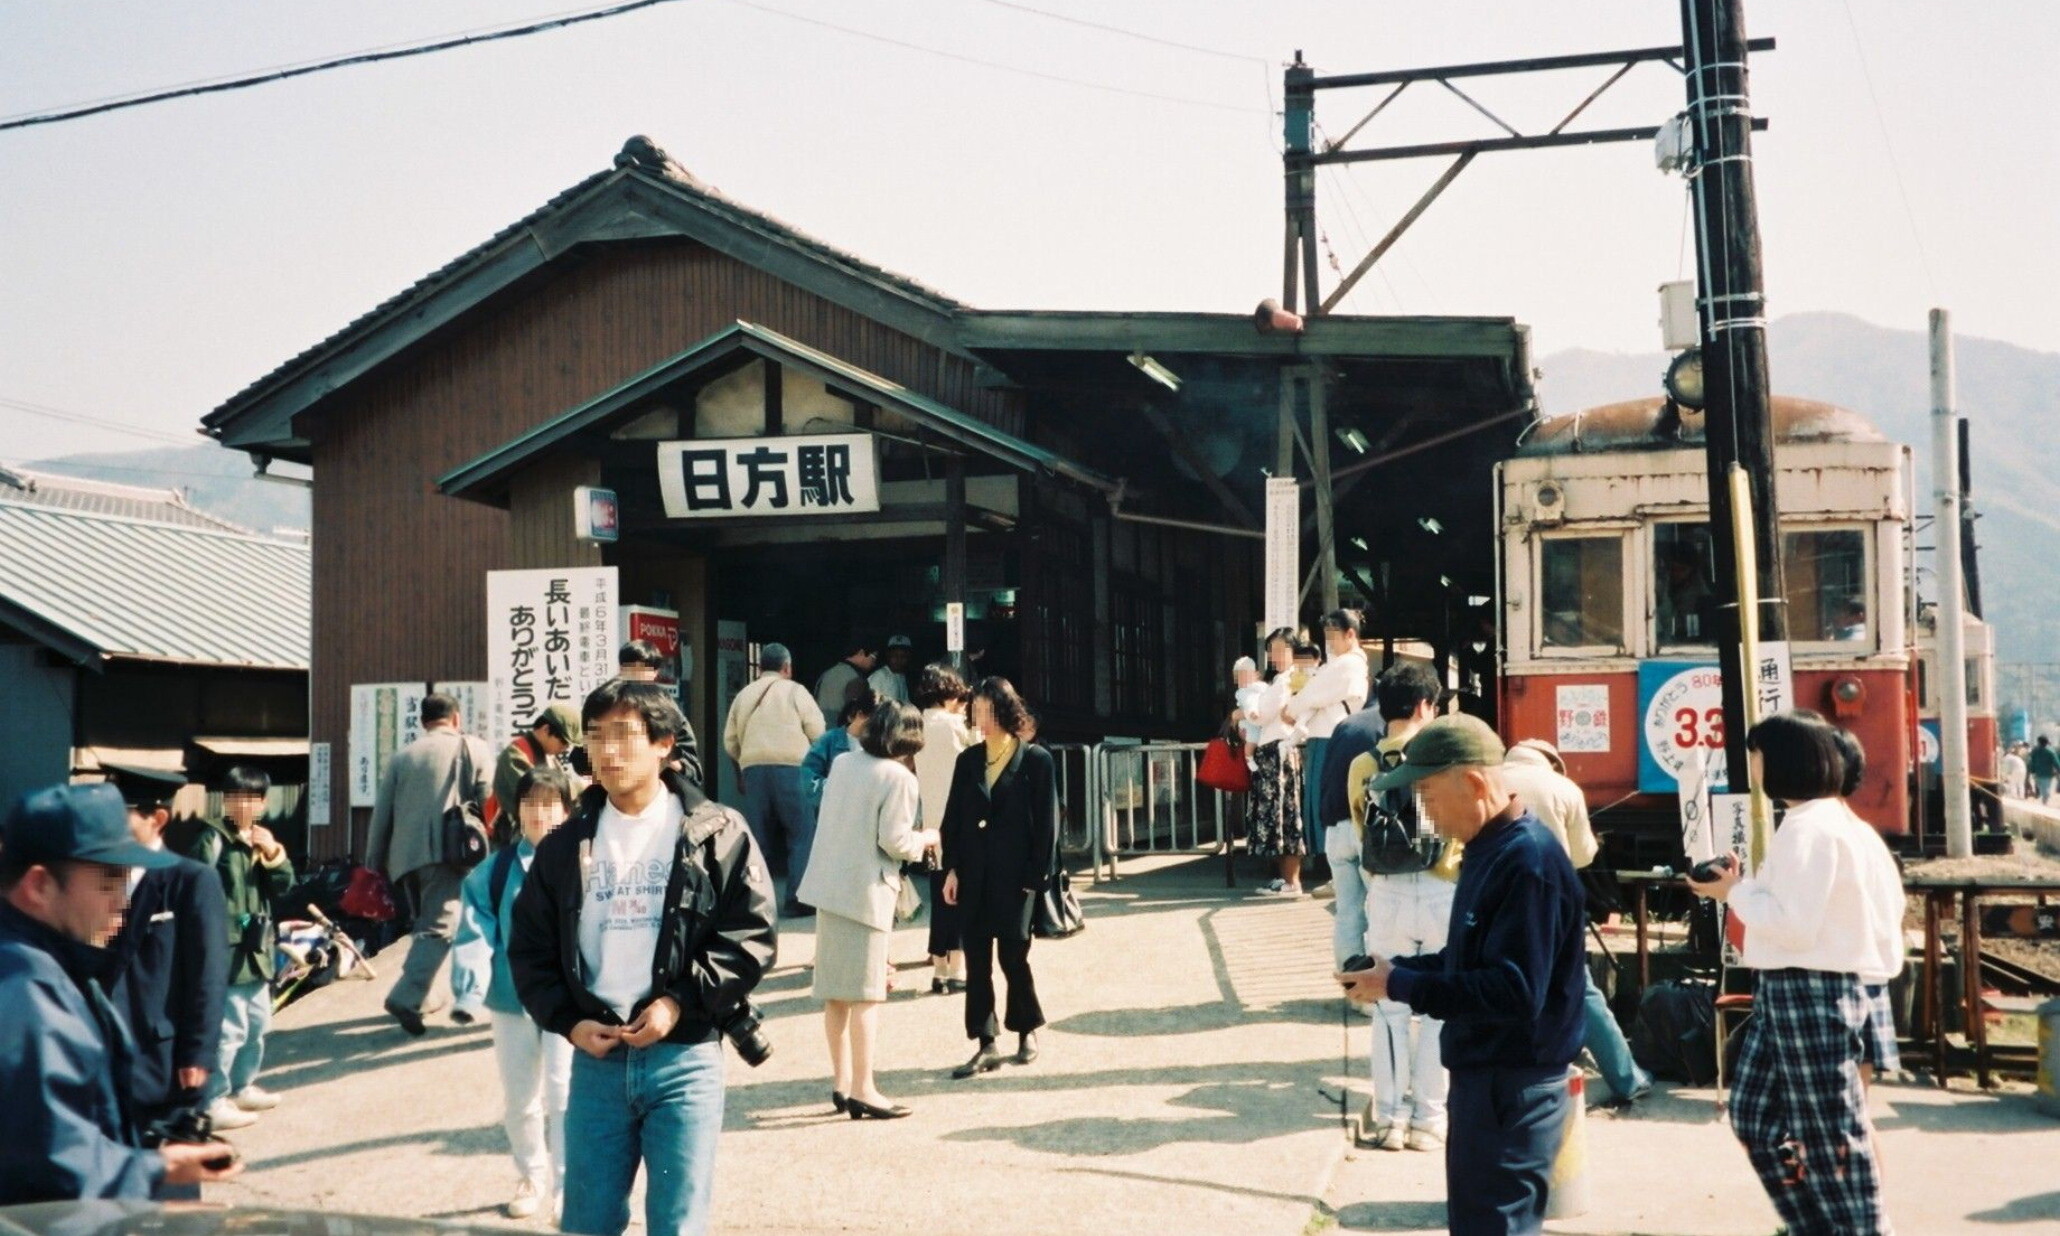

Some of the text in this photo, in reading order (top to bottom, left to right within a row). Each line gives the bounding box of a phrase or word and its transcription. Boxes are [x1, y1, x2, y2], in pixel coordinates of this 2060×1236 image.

[682, 445, 855, 511] 日方駅
[509, 605, 538, 737] ありがとうご
[545, 578, 572, 700] 長いあいだ
[640, 622, 667, 639] POKKA
